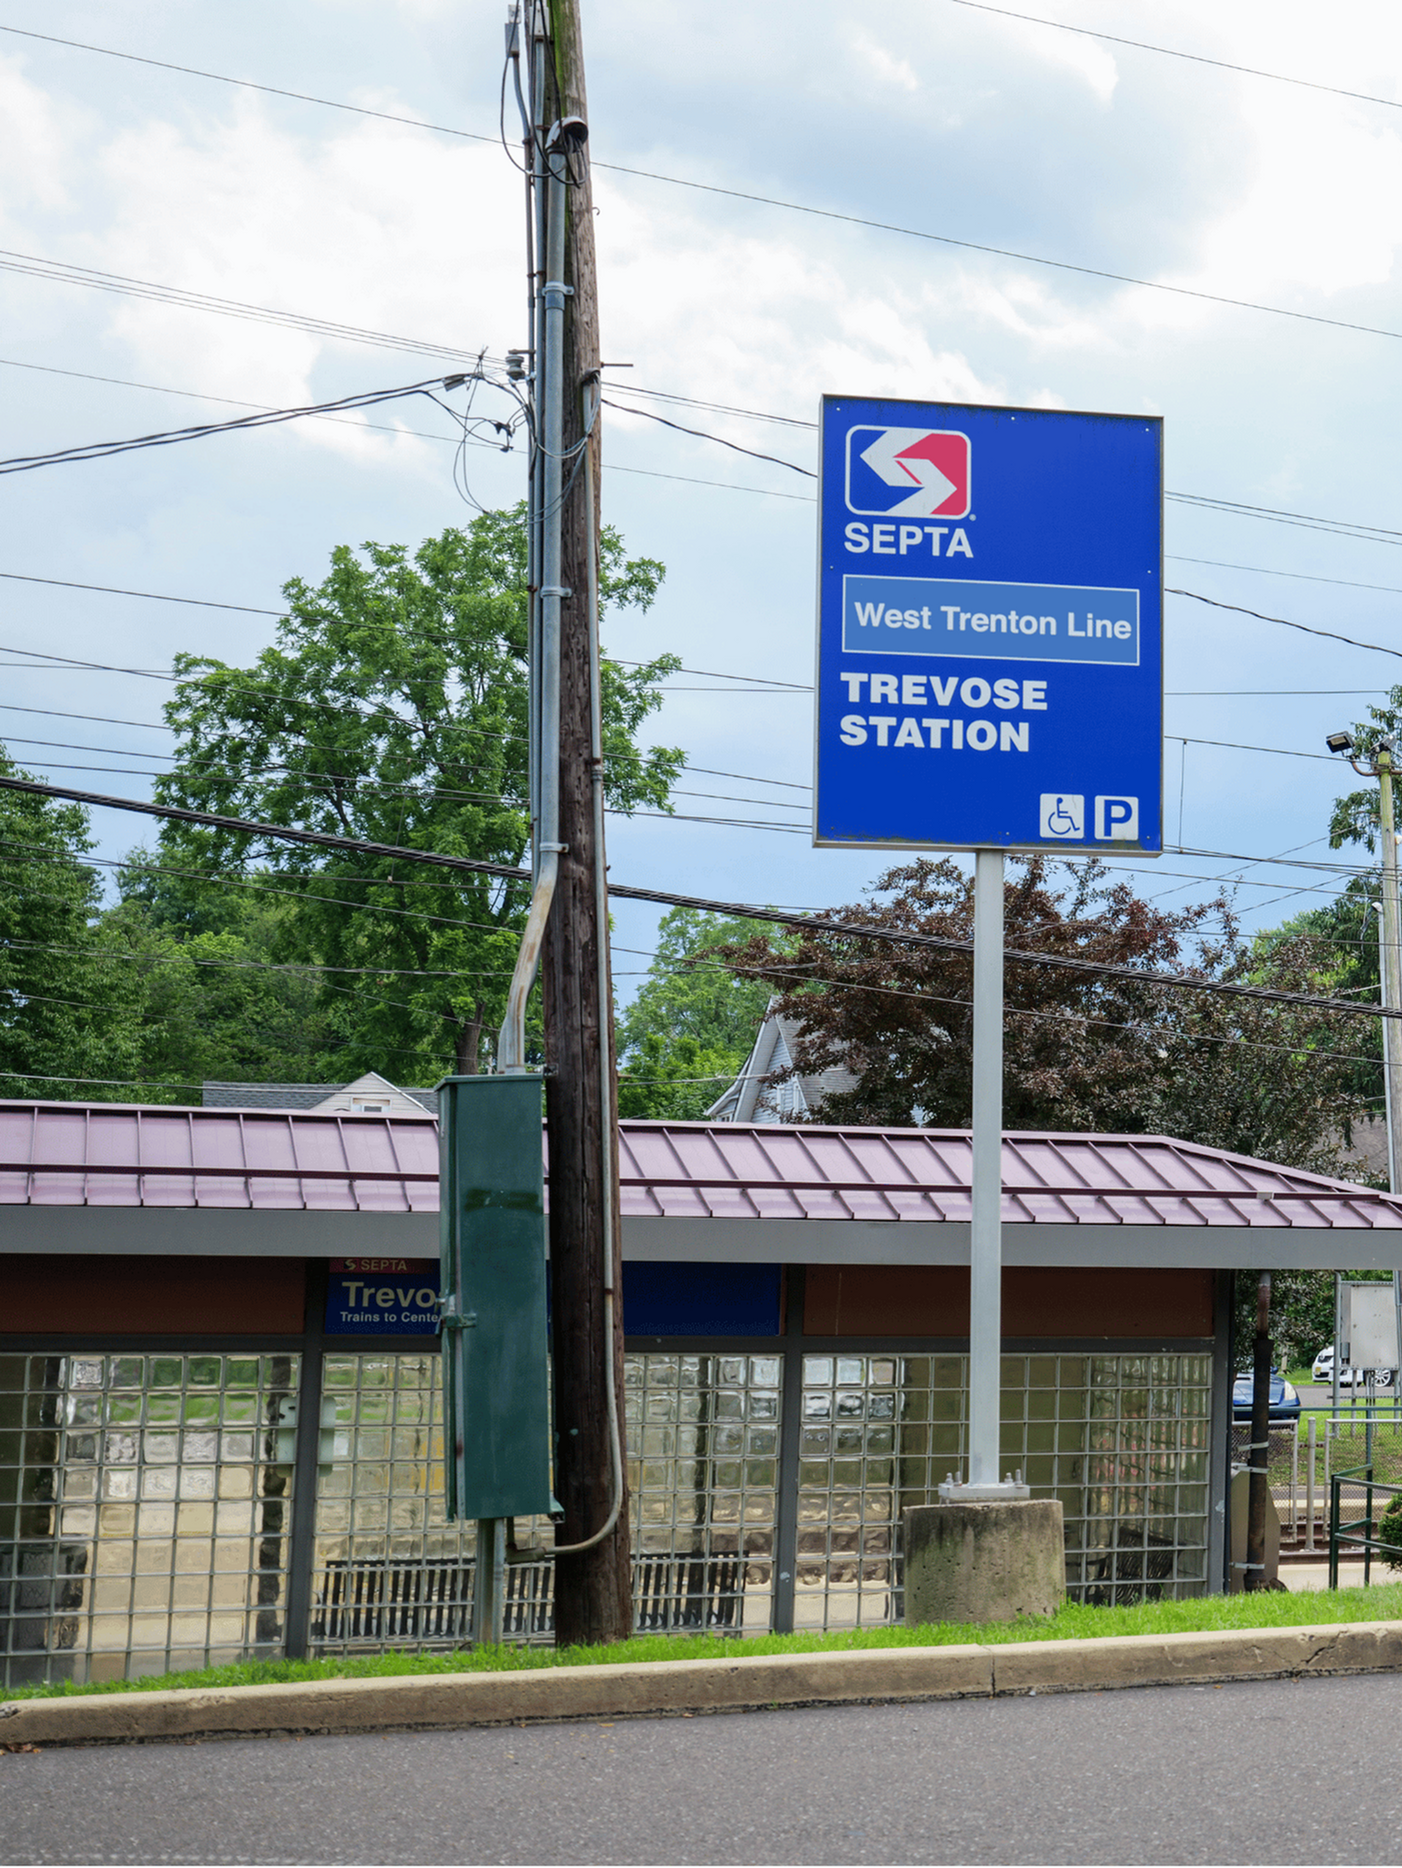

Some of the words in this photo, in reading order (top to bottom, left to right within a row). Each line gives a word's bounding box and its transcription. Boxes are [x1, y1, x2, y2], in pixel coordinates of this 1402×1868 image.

[843, 522, 974, 558] SEPTA
[854, 602, 932, 630] West
[940, 605, 1057, 635] Trenton
[1067, 612, 1132, 639] Line
[840, 672, 1048, 710] TREVOSE
[839, 714, 1030, 752] STATION
[1103, 799, 1133, 837] P
[361, 1259, 407, 1271] SEPTA
[342, 1281, 441, 1308] Trevo
[340, 1311, 380, 1322] Trains
[384, 1312, 397, 1322] to
[401, 1311, 441, 1322] Cente
